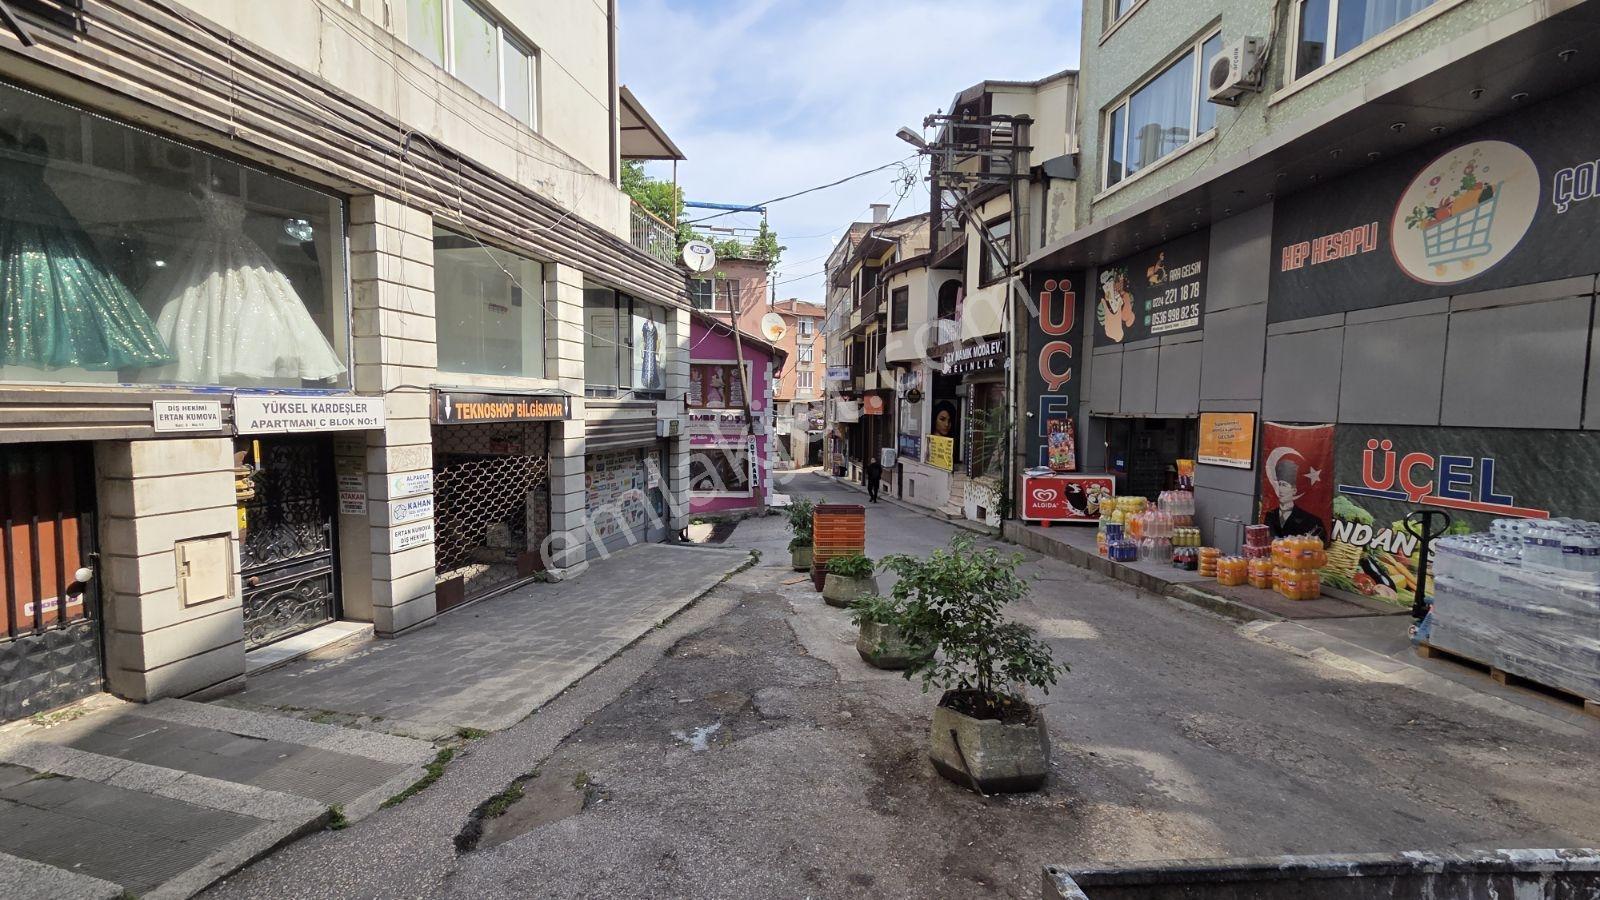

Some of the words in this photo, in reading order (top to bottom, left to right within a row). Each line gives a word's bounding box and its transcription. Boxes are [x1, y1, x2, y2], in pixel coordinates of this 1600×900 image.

[1281, 241, 1310, 272] HEP
[1311, 221, 1379, 265] HESAPLI
[1165, 288, 1178, 305] 221
[1180, 284, 1189, 301] 18
[1190, 281, 1200, 299] 78
[1167, 308, 1180, 322] 998
[1180, 306, 1190, 320] 82
[1190, 303, 1200, 318] 35
[159, 413, 184, 421] ERTAN
[262, 400, 308, 414] YÜKSEL
[311, 402, 368, 415] KARDEŞLER
[455, 402, 514, 420] TEKNOSHOP
[516, 399, 563, 418] BİLGİSAYAR
[250, 419, 316, 429] APARTMANI
[319, 418, 327, 427] C
[329, 417, 355, 426] BLOK
[357, 417, 378, 426] NO:1
[1362, 438, 1514, 507] ÜÇEL
[407, 499, 431, 510] KAHAN
[1331, 519, 1418, 556] NDAN
